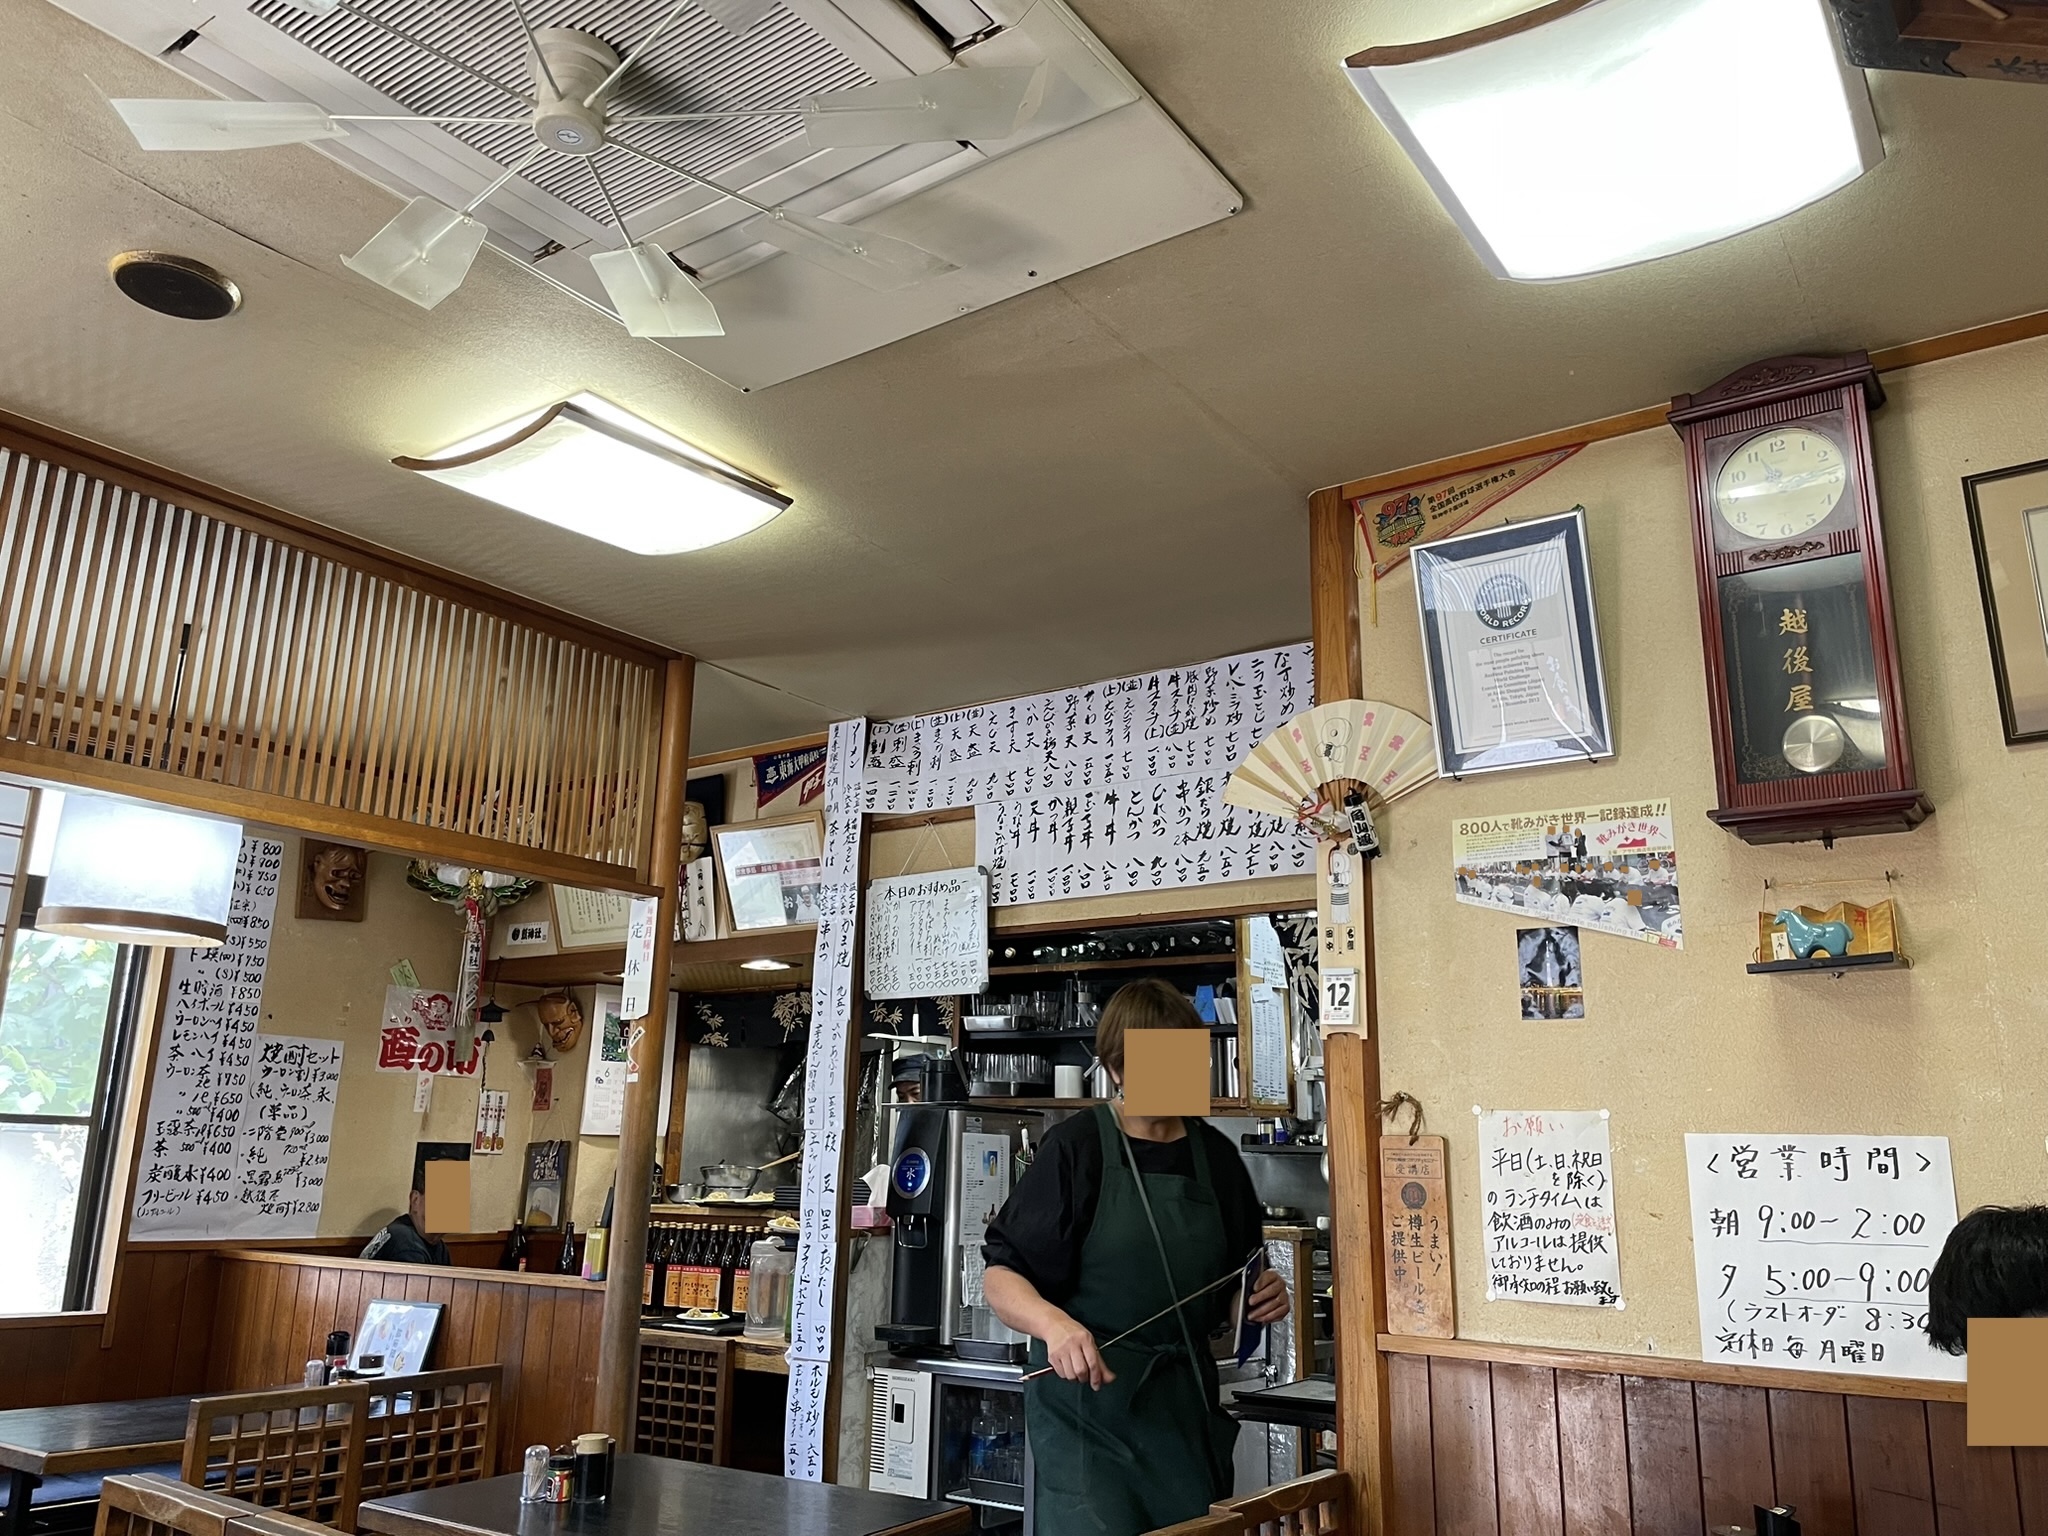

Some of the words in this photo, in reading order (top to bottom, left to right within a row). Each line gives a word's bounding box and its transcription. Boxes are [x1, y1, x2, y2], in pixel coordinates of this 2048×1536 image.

[1769, 439, 1786, 453] 12
[1817, 450, 1830, 463] 2
[1747, 451, 1762, 464] 11
[1730, 470, 1746, 483] 10
[1429, 469, 1516, 512] 全国高校野球選手権大会
[1480, 628, 1537, 645] CERTIFICATE
[1778, 608, 1815, 713] 越後屋
[626, 923, 643, 1013] 定休日
[1327, 983, 1350, 1007] 12
[1503, 1115, 1564, 1137] お願い
[1710, 1208, 1739, 1237] 朝
